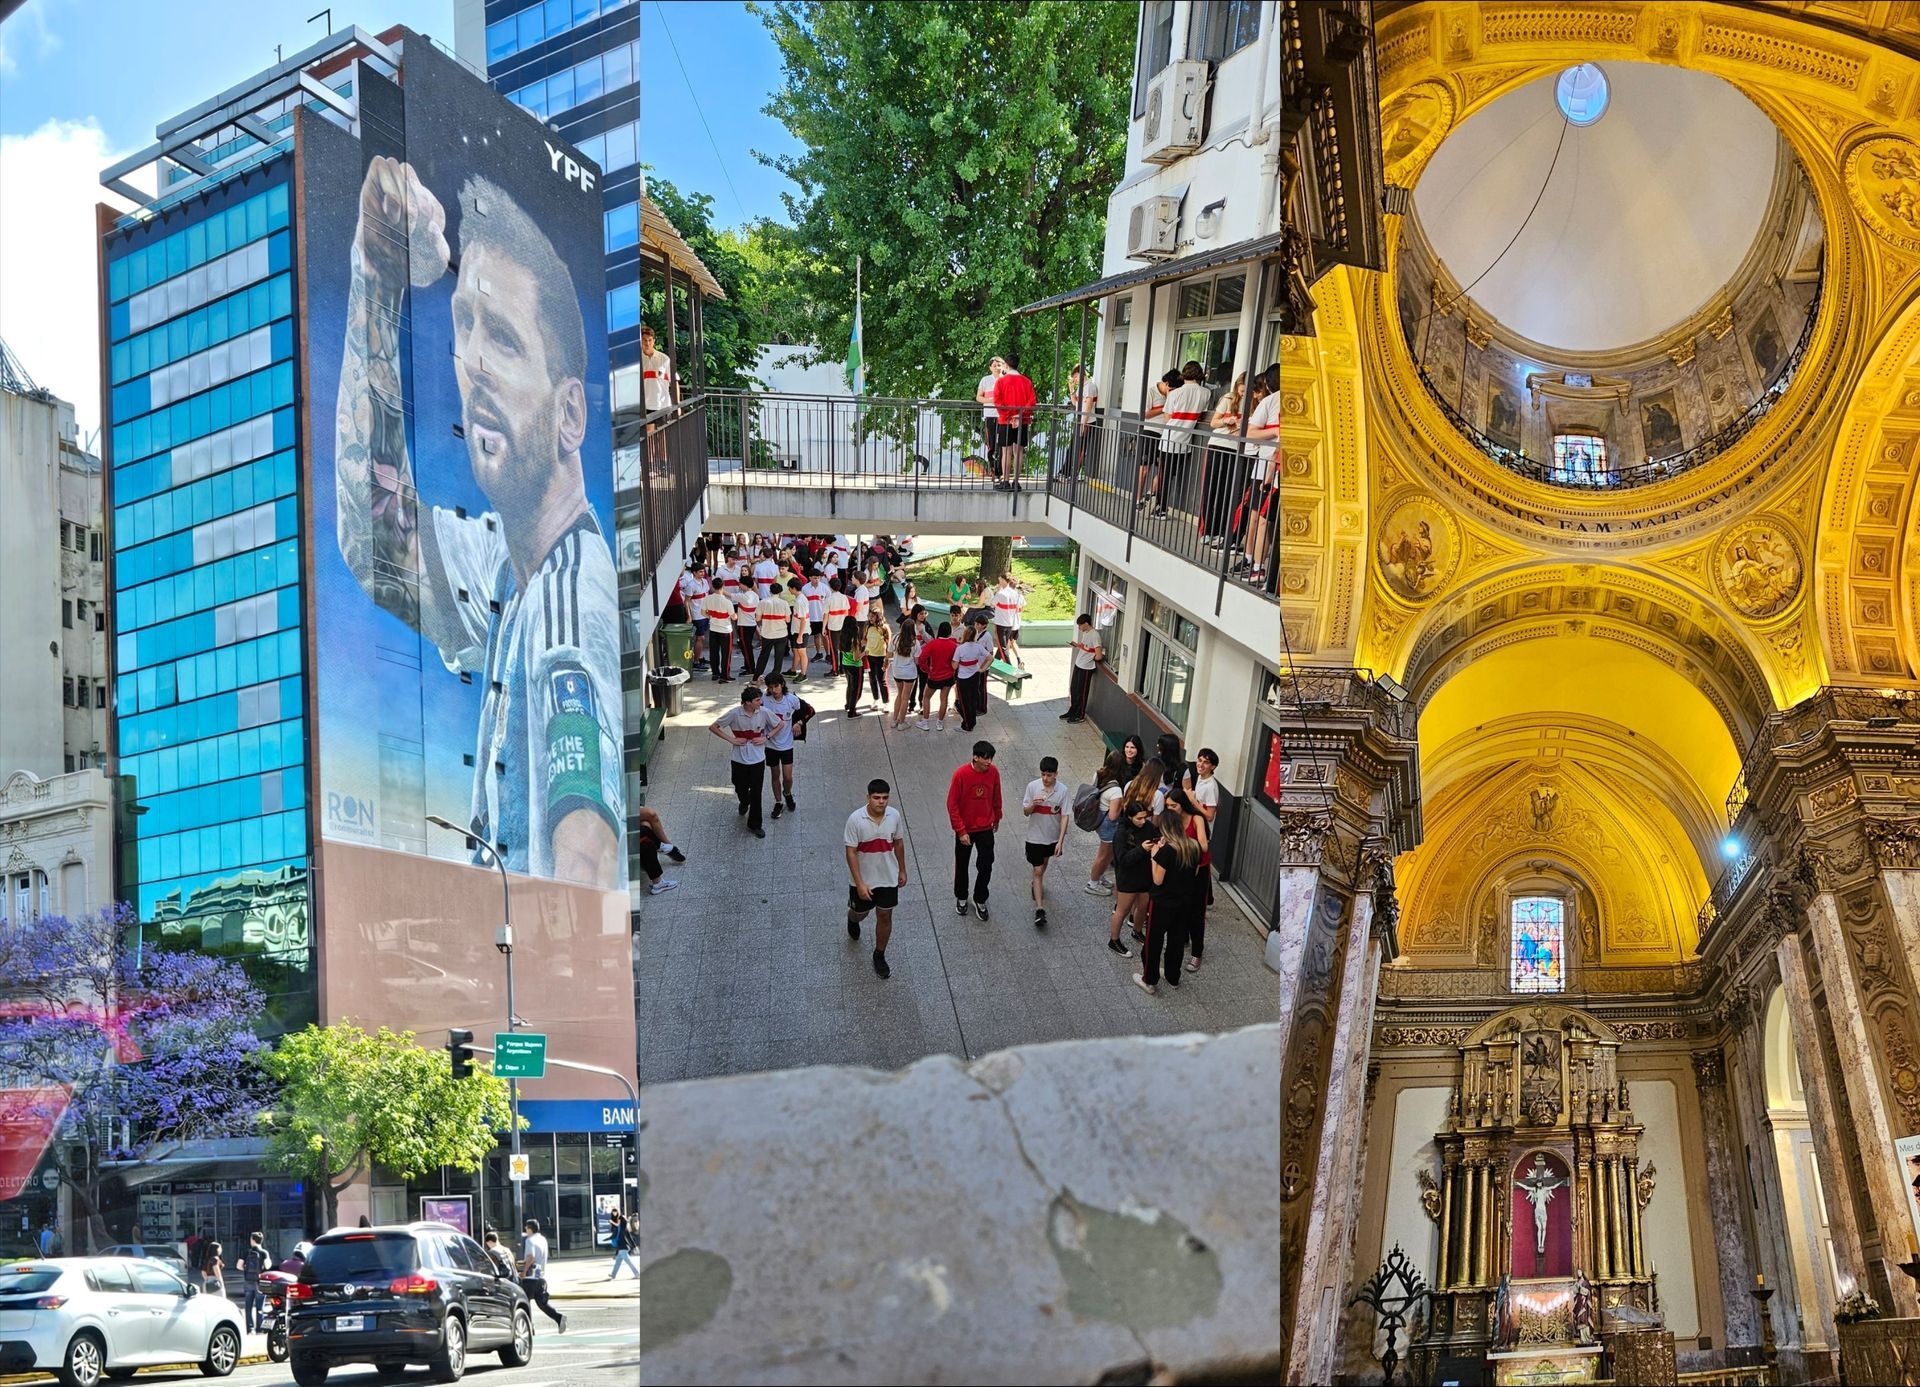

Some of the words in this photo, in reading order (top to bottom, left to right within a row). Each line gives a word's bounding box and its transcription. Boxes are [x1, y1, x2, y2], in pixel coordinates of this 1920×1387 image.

[543, 139, 596, 193] YPF
[1629, 509, 1682, 531] MATT
[1695, 484, 1740, 512] CXVI
[557, 734, 585, 754] THE
[328, 791, 375, 827] RON
